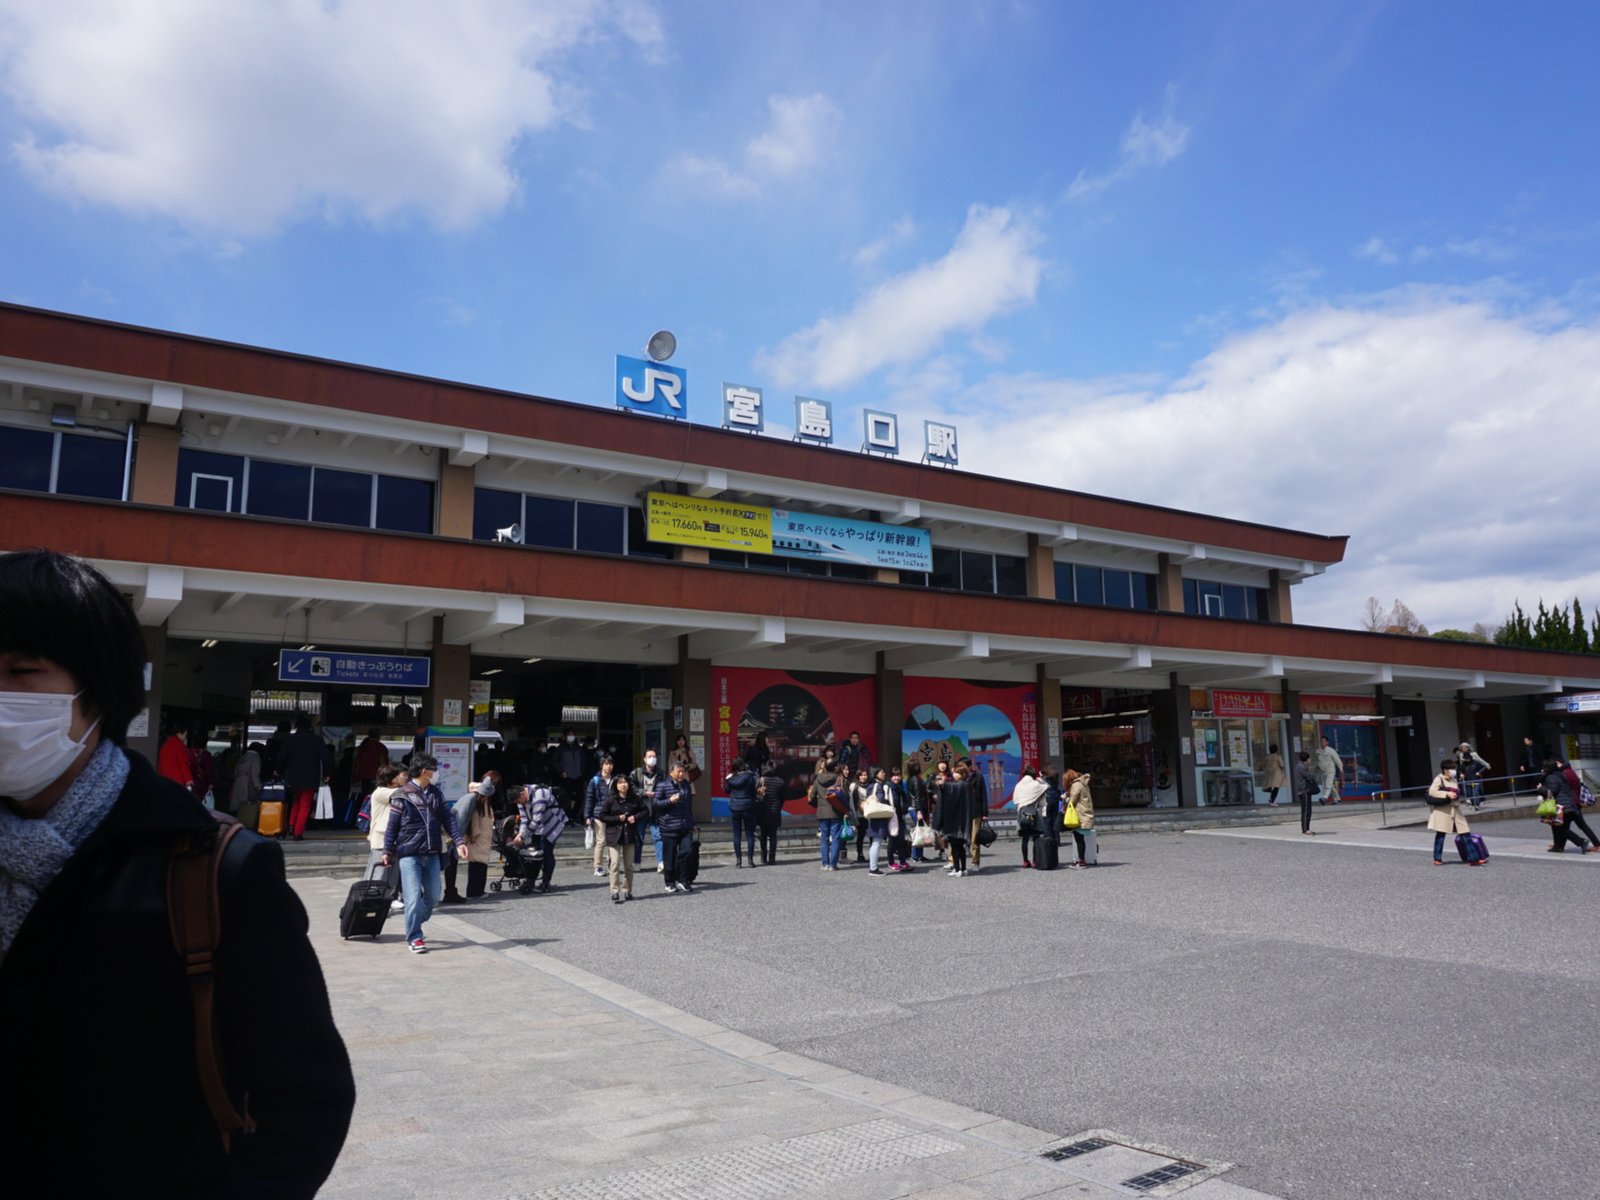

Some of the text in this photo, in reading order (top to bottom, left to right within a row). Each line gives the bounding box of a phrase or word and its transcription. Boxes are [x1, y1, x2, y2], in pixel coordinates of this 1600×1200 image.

[622, 368, 681, 409] JR
[727, 388, 957, 460] 宮島口駅
[335, 659, 414, 672] 自動きっぷうりば
[1219, 693, 1251, 709] DAILY
[719, 705, 730, 734] 宮島
